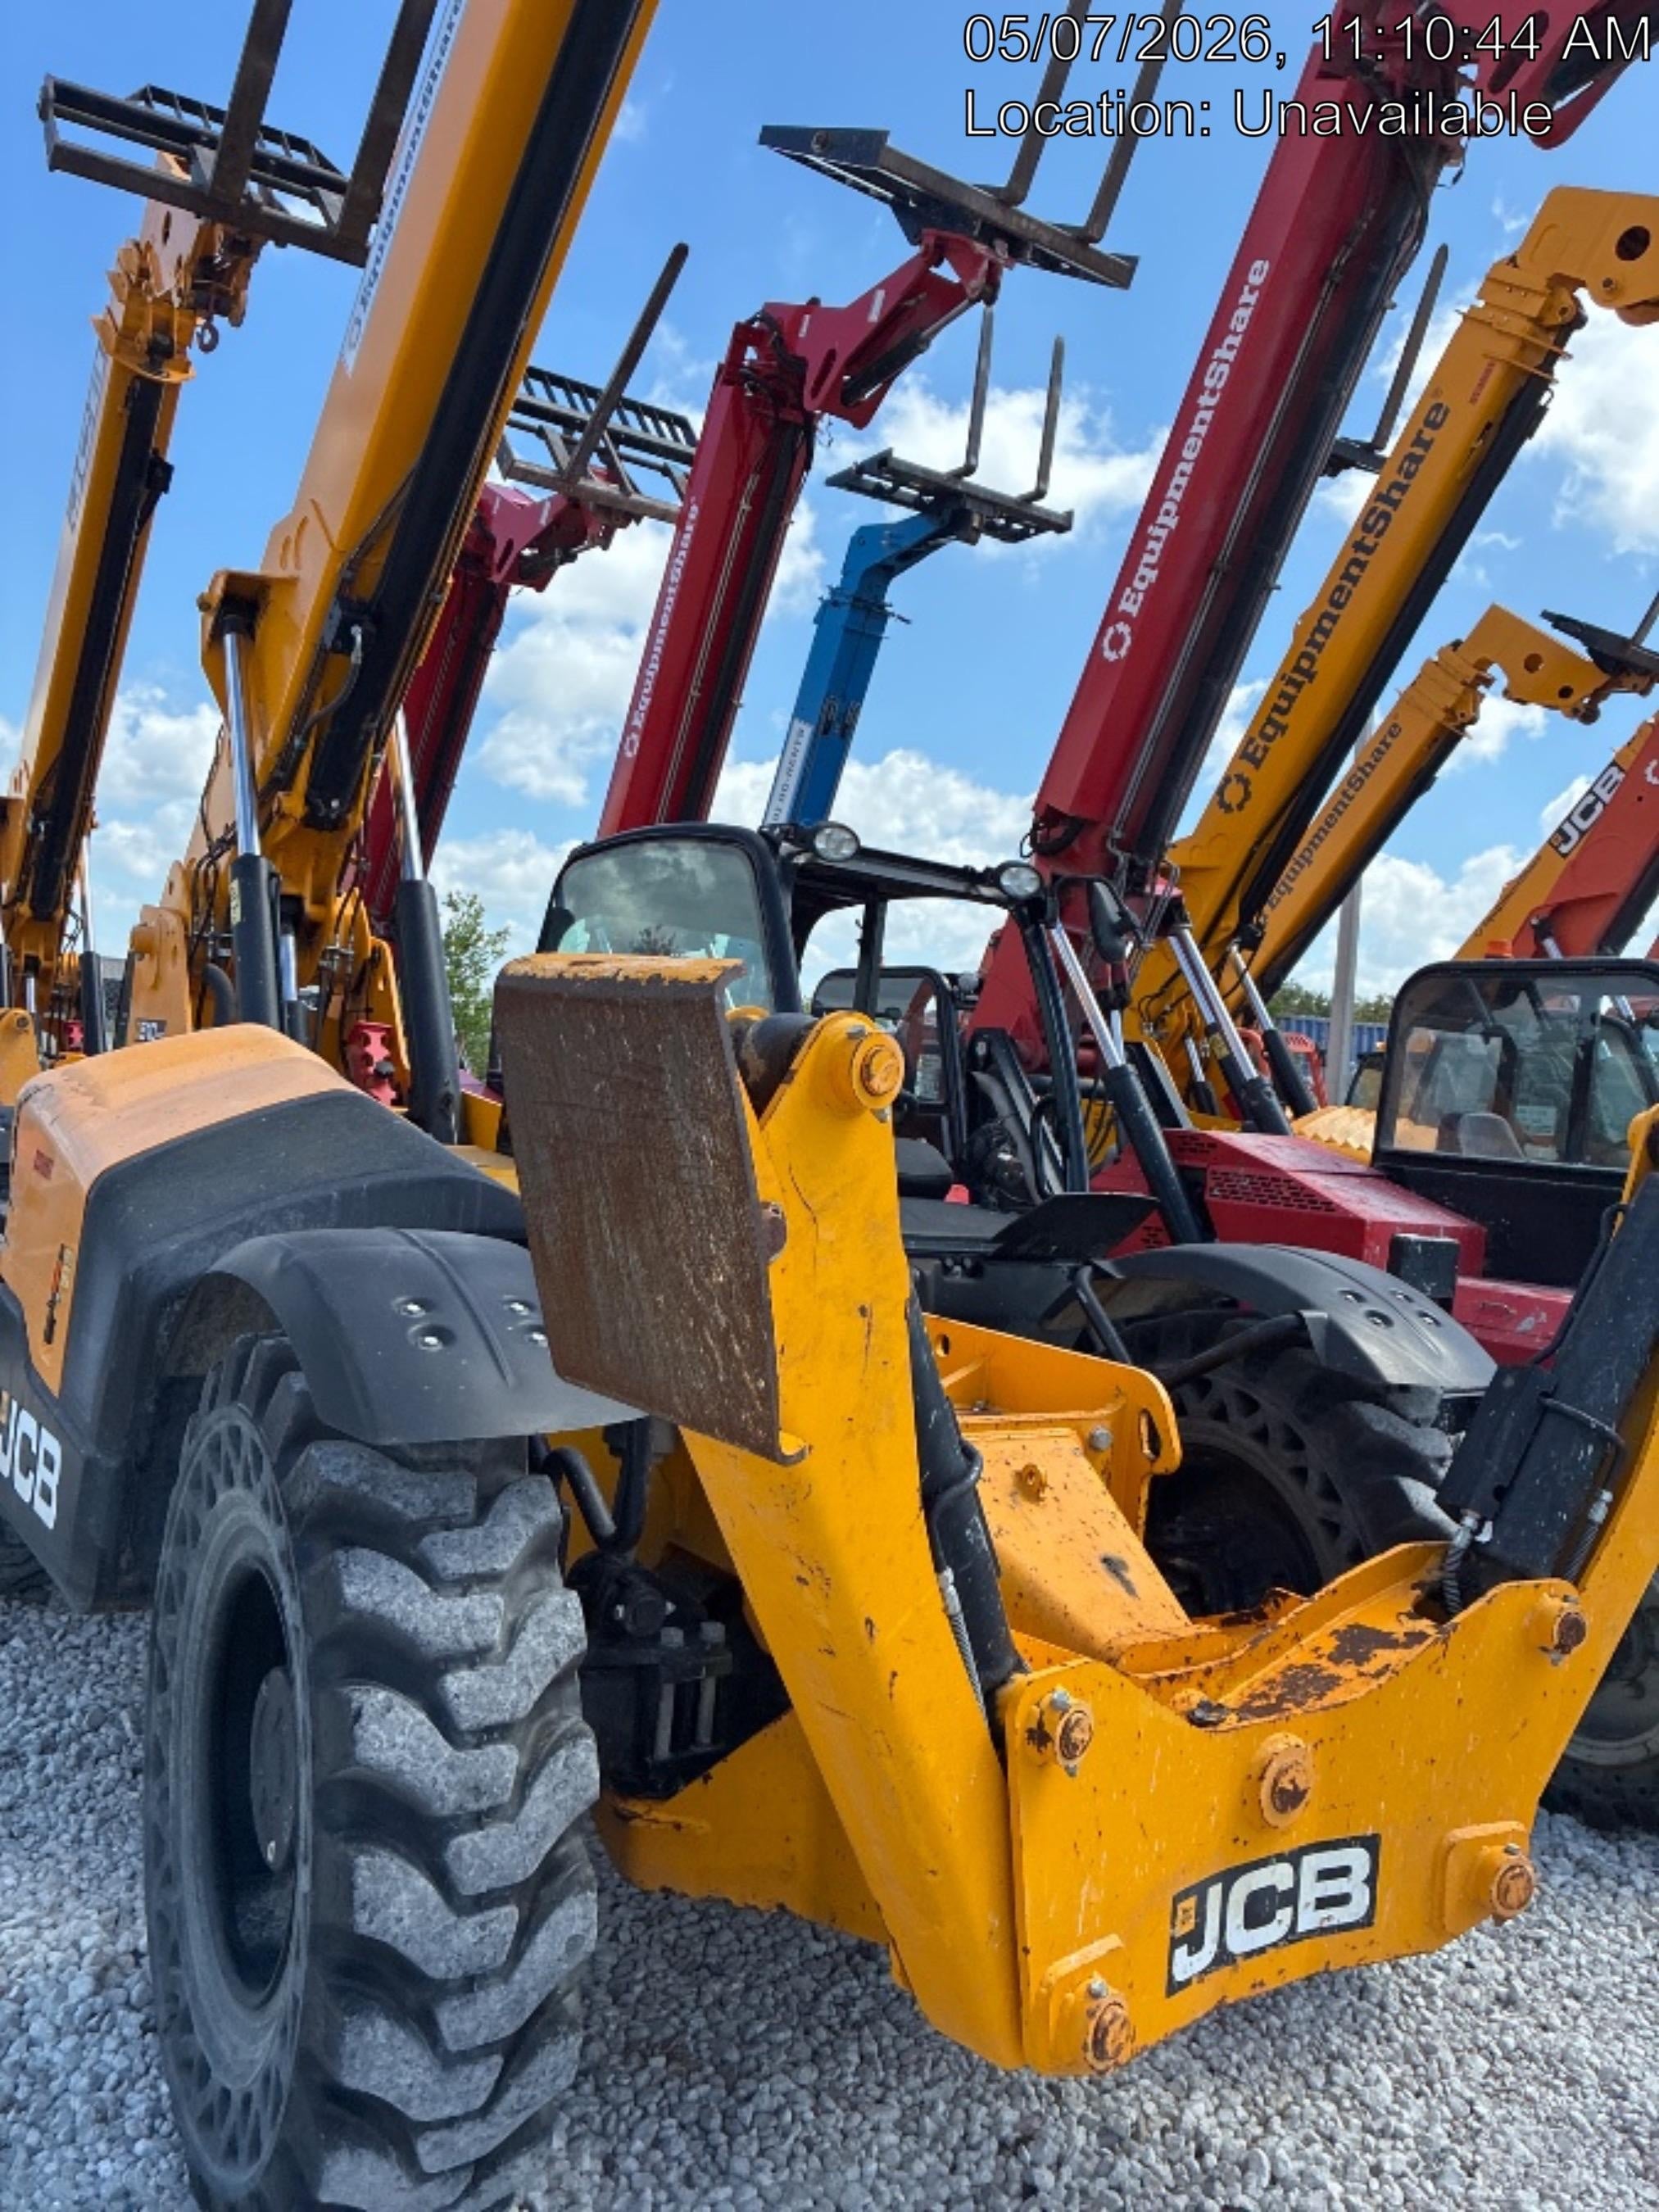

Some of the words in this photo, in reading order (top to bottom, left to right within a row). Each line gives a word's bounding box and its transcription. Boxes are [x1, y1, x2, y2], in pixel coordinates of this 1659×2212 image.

[1118, 259, 1269, 618] EquipmentShare
[1240, 401, 1450, 770] EquipmentShare
[1557, 765, 1625, 854] JCB
[0, 1398, 61, 1530] JCB
[1172, 1847, 1371, 1982] JCB
